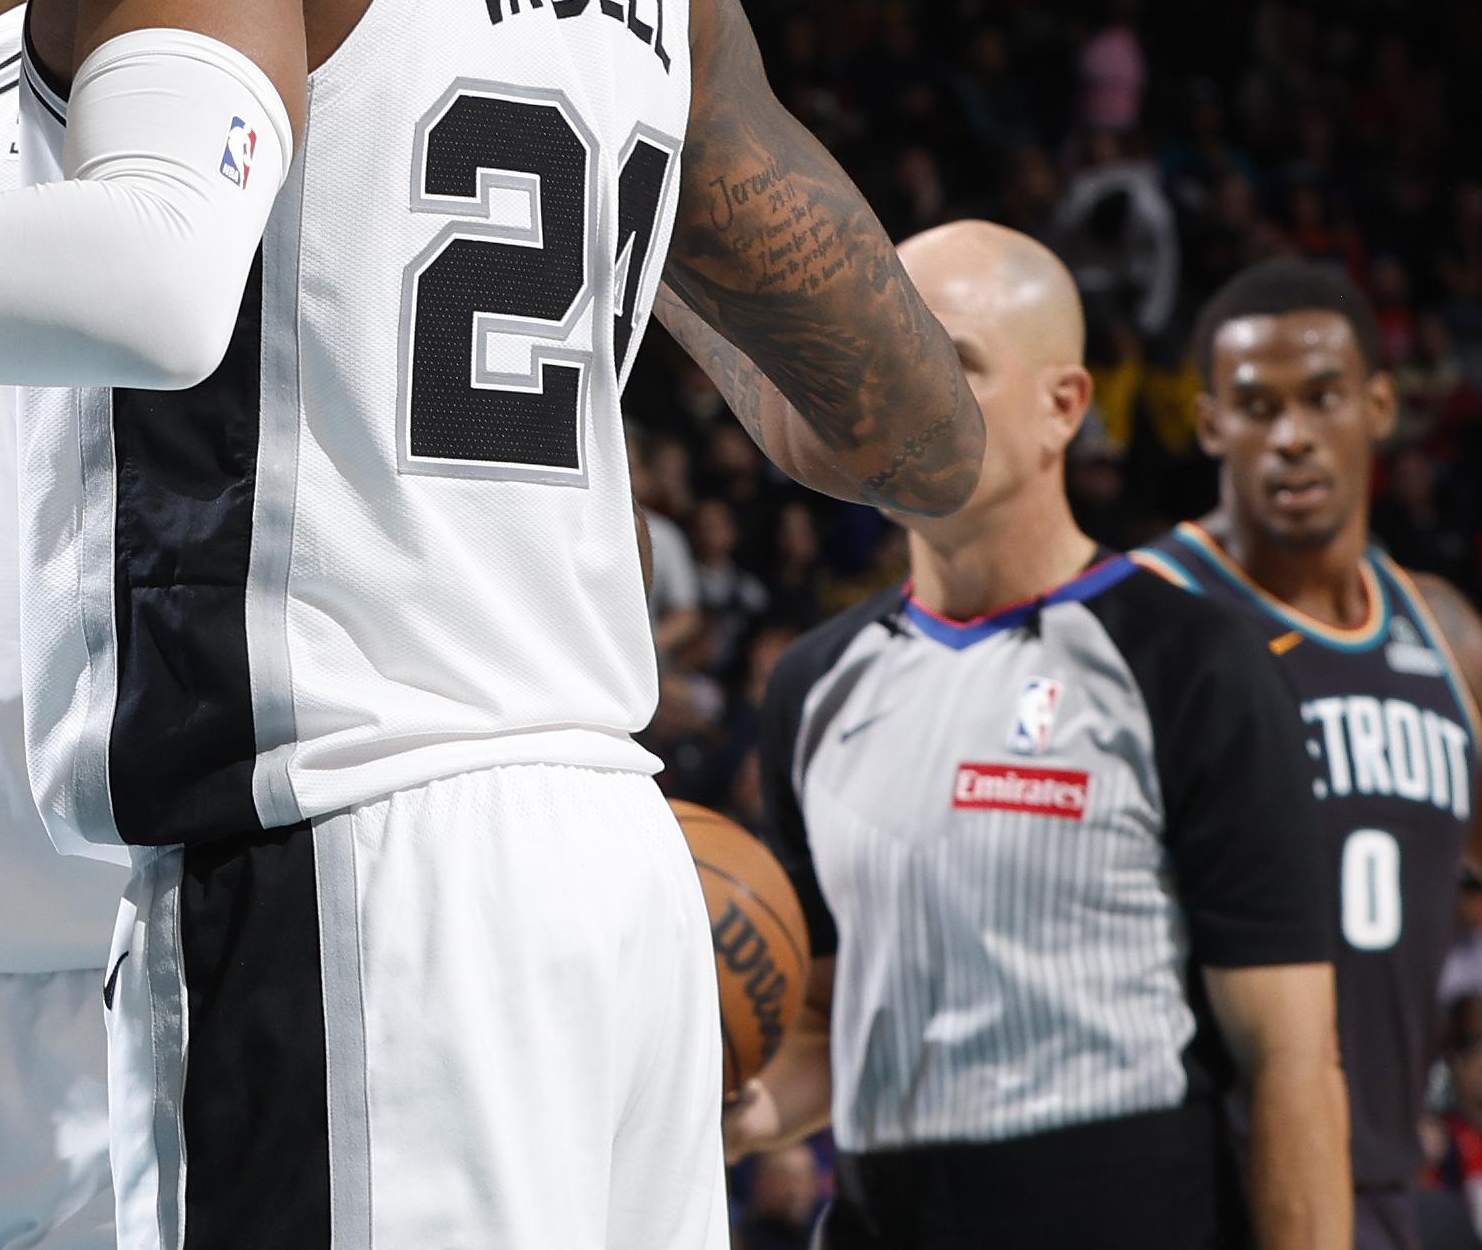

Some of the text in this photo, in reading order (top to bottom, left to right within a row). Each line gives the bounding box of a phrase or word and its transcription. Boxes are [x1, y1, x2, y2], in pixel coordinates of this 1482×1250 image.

[955, 768, 1086, 810] Emirates
[1300, 695, 1471, 821] TROIT
[1341, 827, 1403, 951] 0
[713, 899, 788, 1058] Wils
